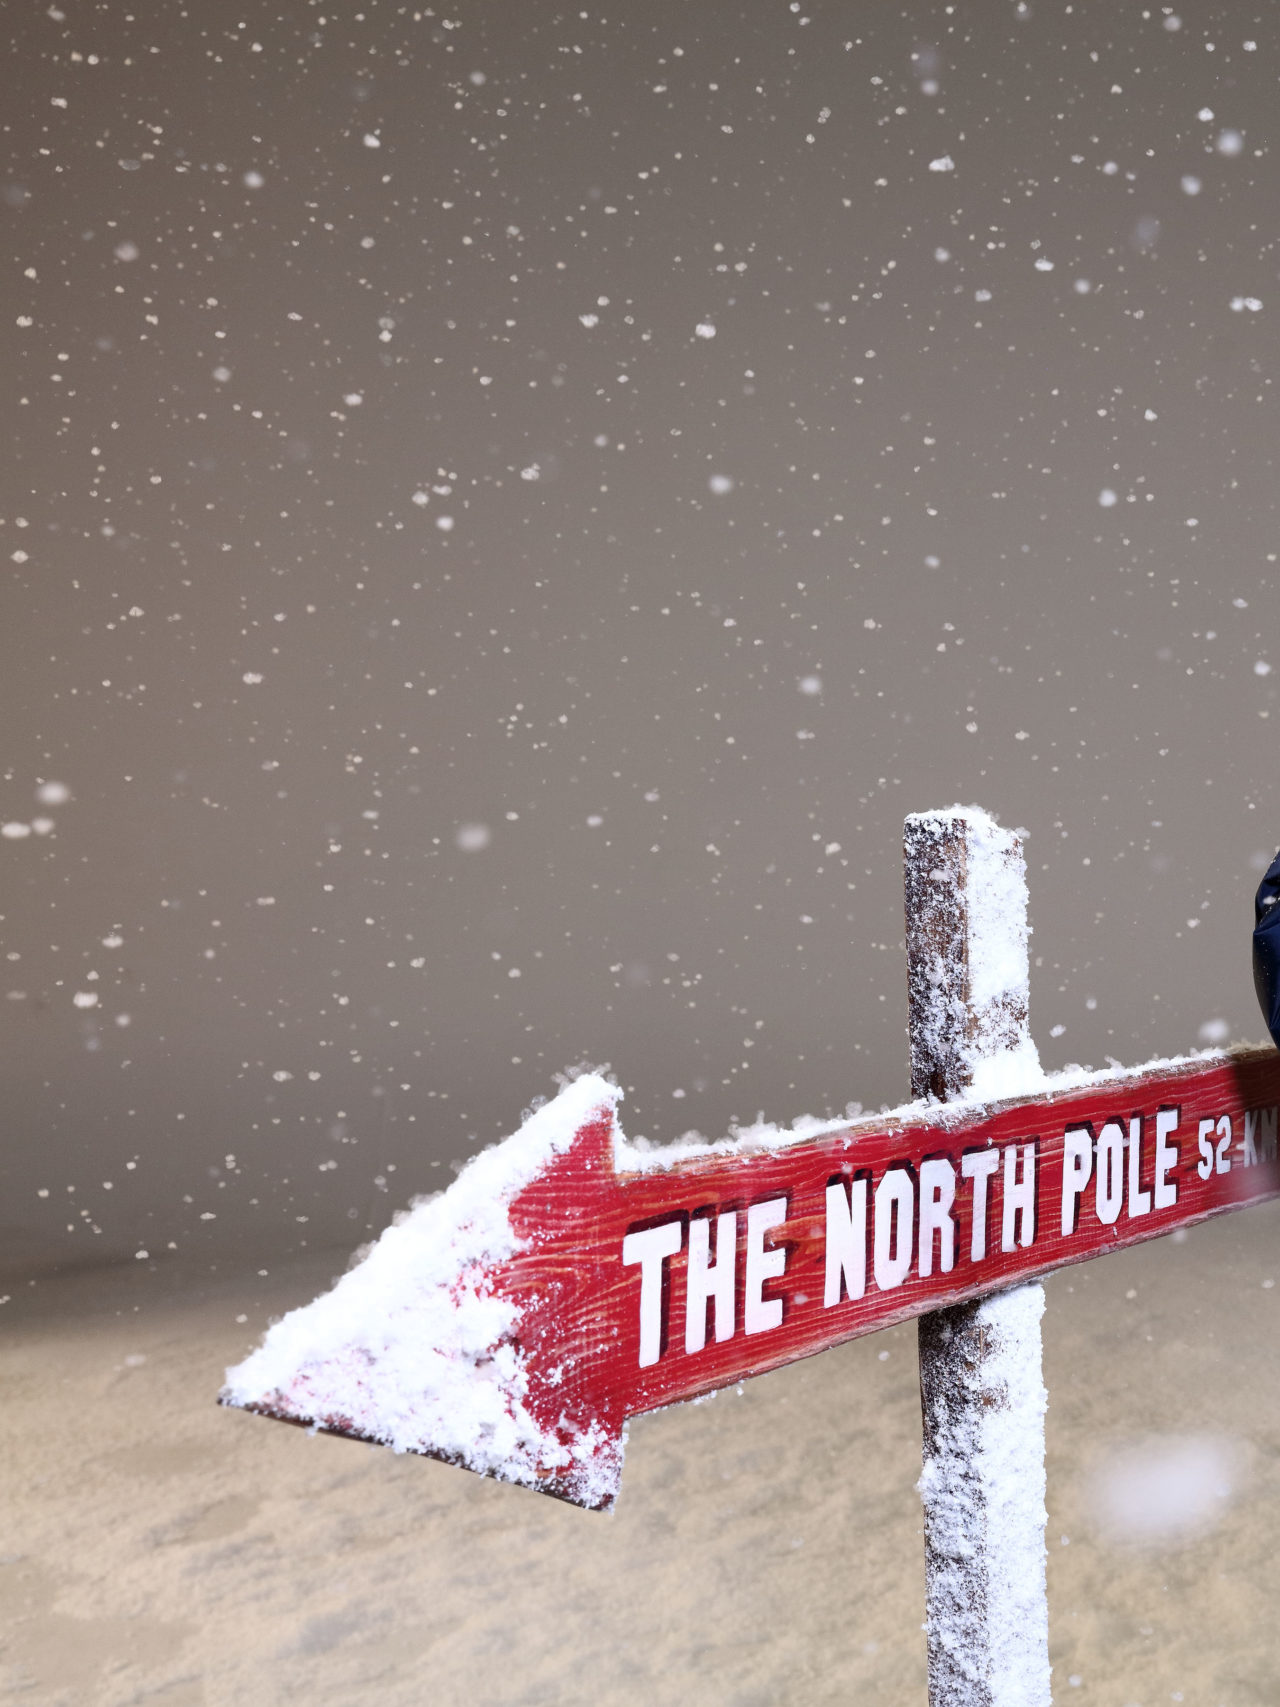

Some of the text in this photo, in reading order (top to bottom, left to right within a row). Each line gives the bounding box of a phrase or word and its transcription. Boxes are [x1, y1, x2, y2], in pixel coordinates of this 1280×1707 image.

[622, 1106, 1279, 1368] THE NORTH POLE 52 KM
